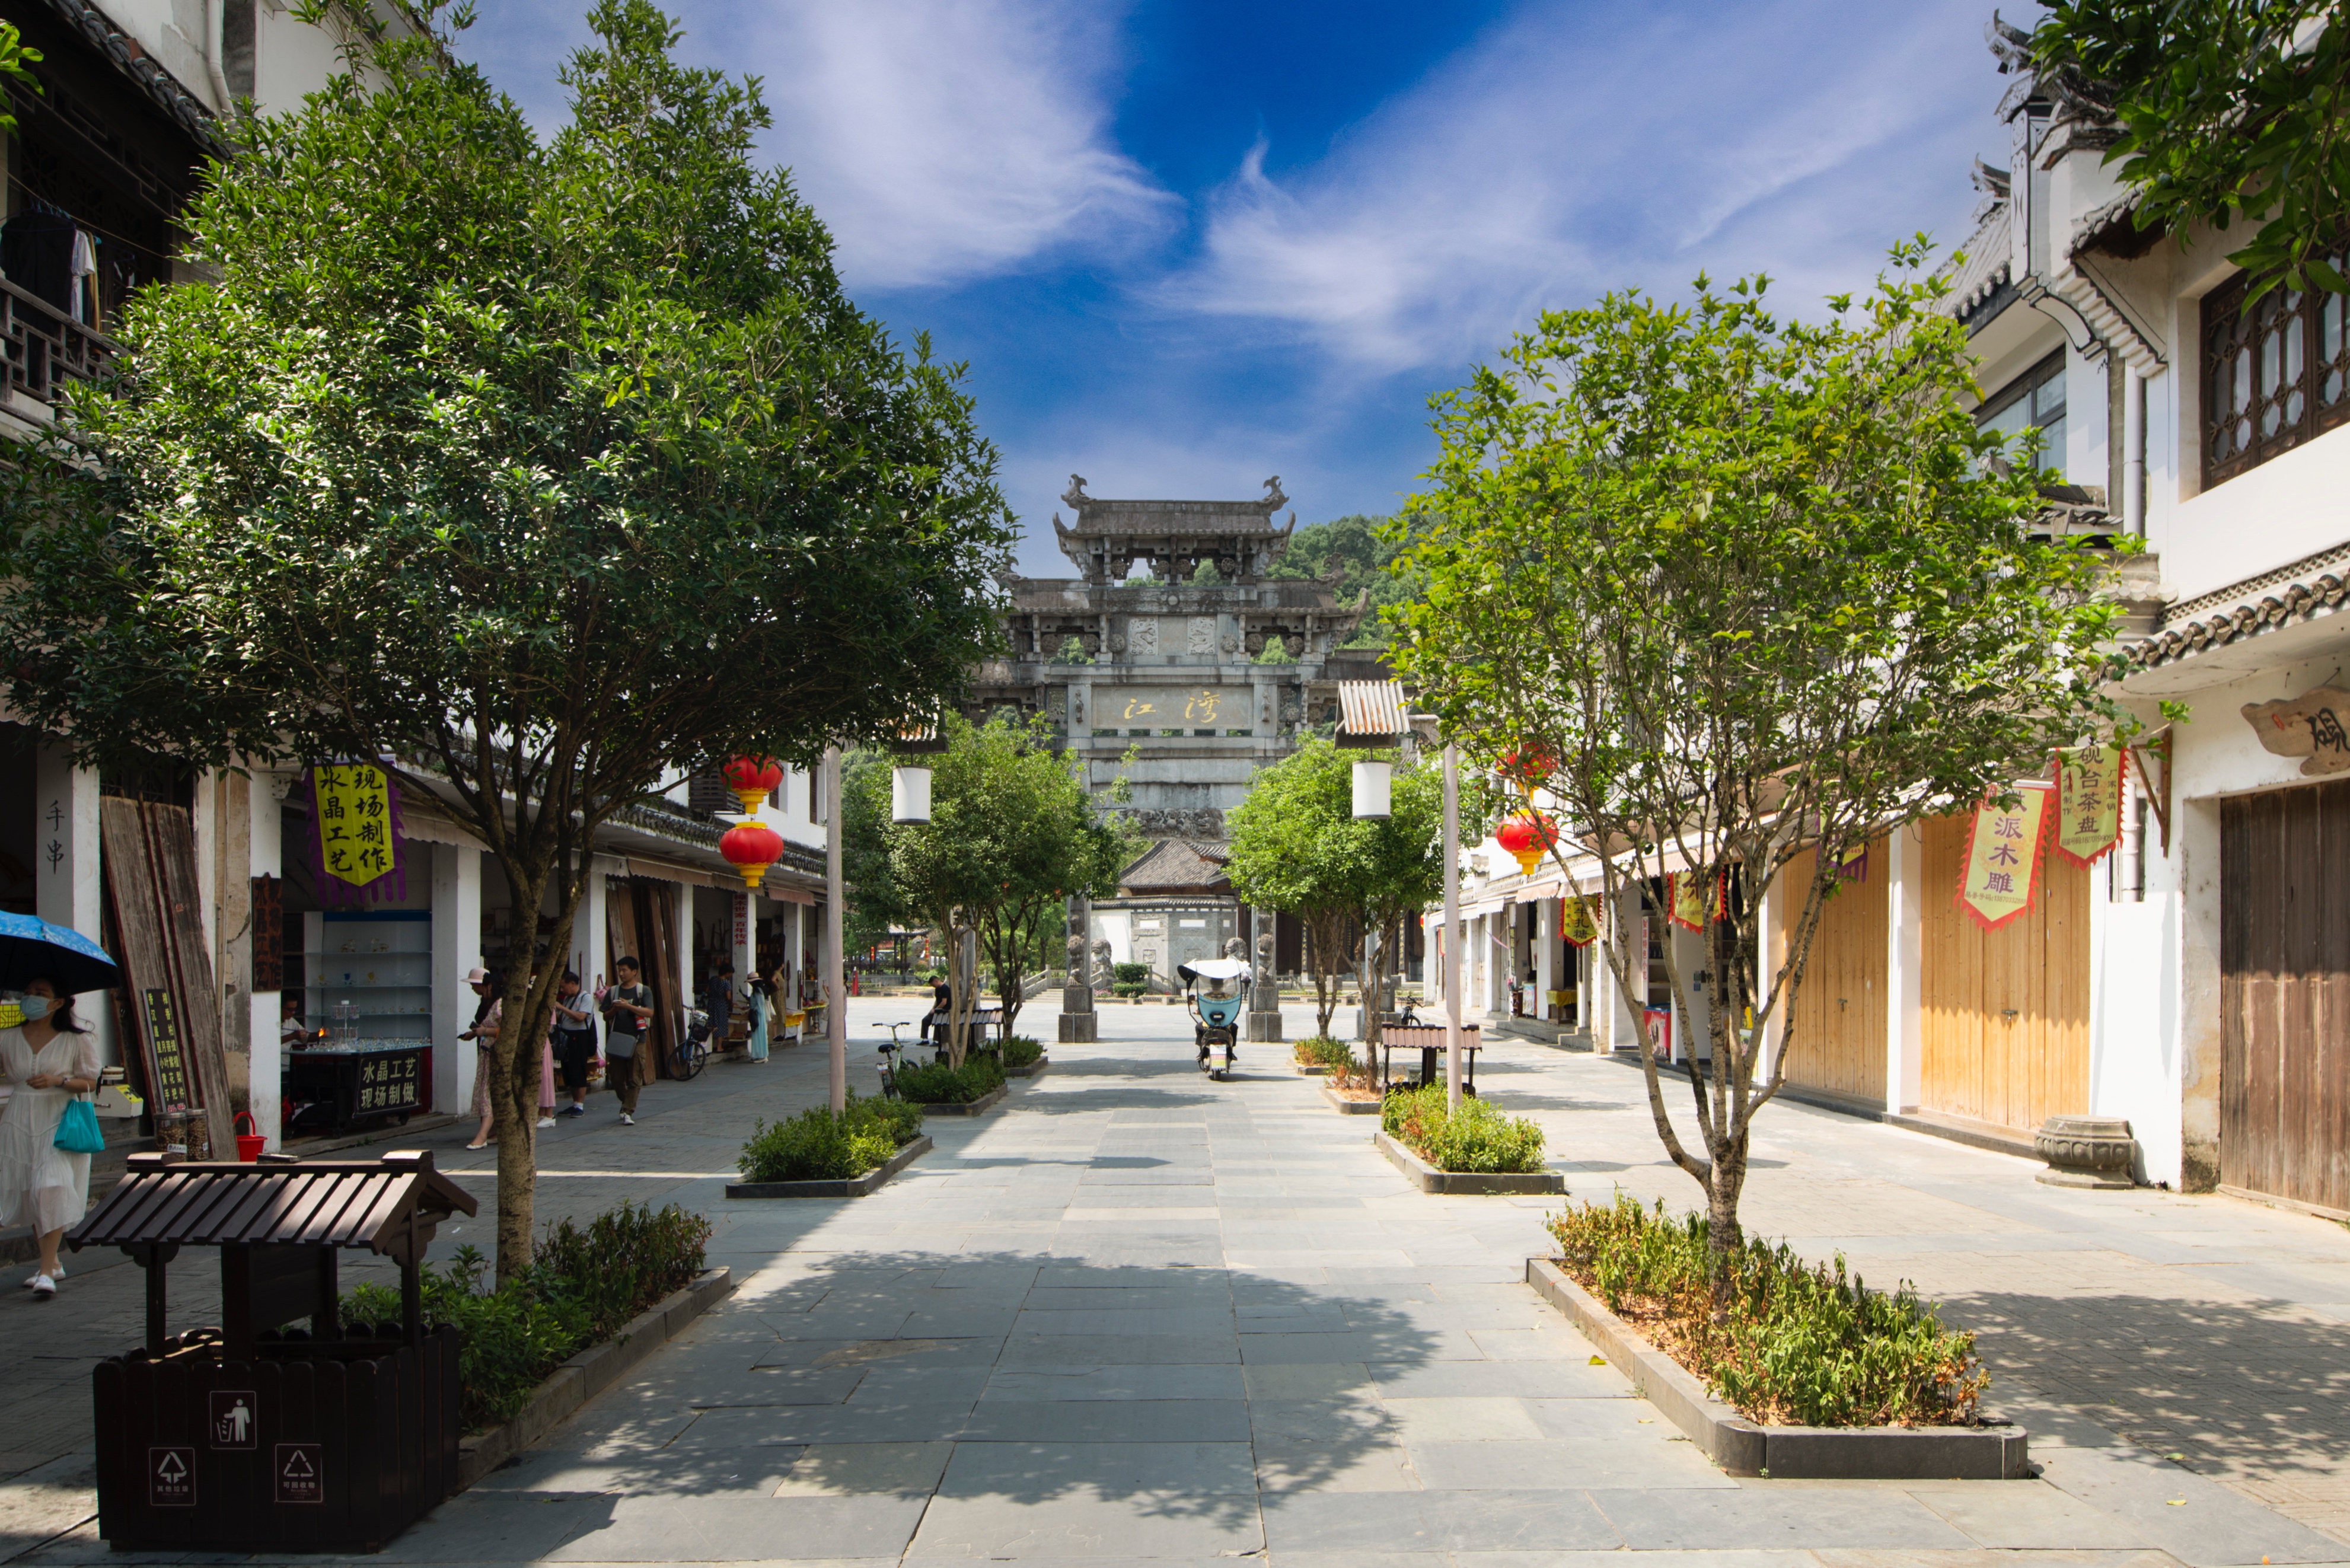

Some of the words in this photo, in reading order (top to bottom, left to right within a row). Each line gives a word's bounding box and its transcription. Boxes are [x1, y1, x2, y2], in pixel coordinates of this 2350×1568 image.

[2074, 745, 2105, 835] 砚台茶盘
[2106, 769, 2118, 811] 厂家直销
[46, 799, 65, 875] 手串
[320, 769, 353, 872] 水晶工艺
[354, 769, 387, 872] 现场制作
[255, 878, 269, 987] 水晶工艺
[734, 921, 747, 946] 百年传承
[157, 1040, 177, 1053] 星月菩提
[160, 1055, 180, 1069] 小叶紫檀
[363, 1057, 416, 1083] 水晶工艺
[164, 1086, 184, 1101] 手把件
[361, 1082, 414, 1109] 现场制做
